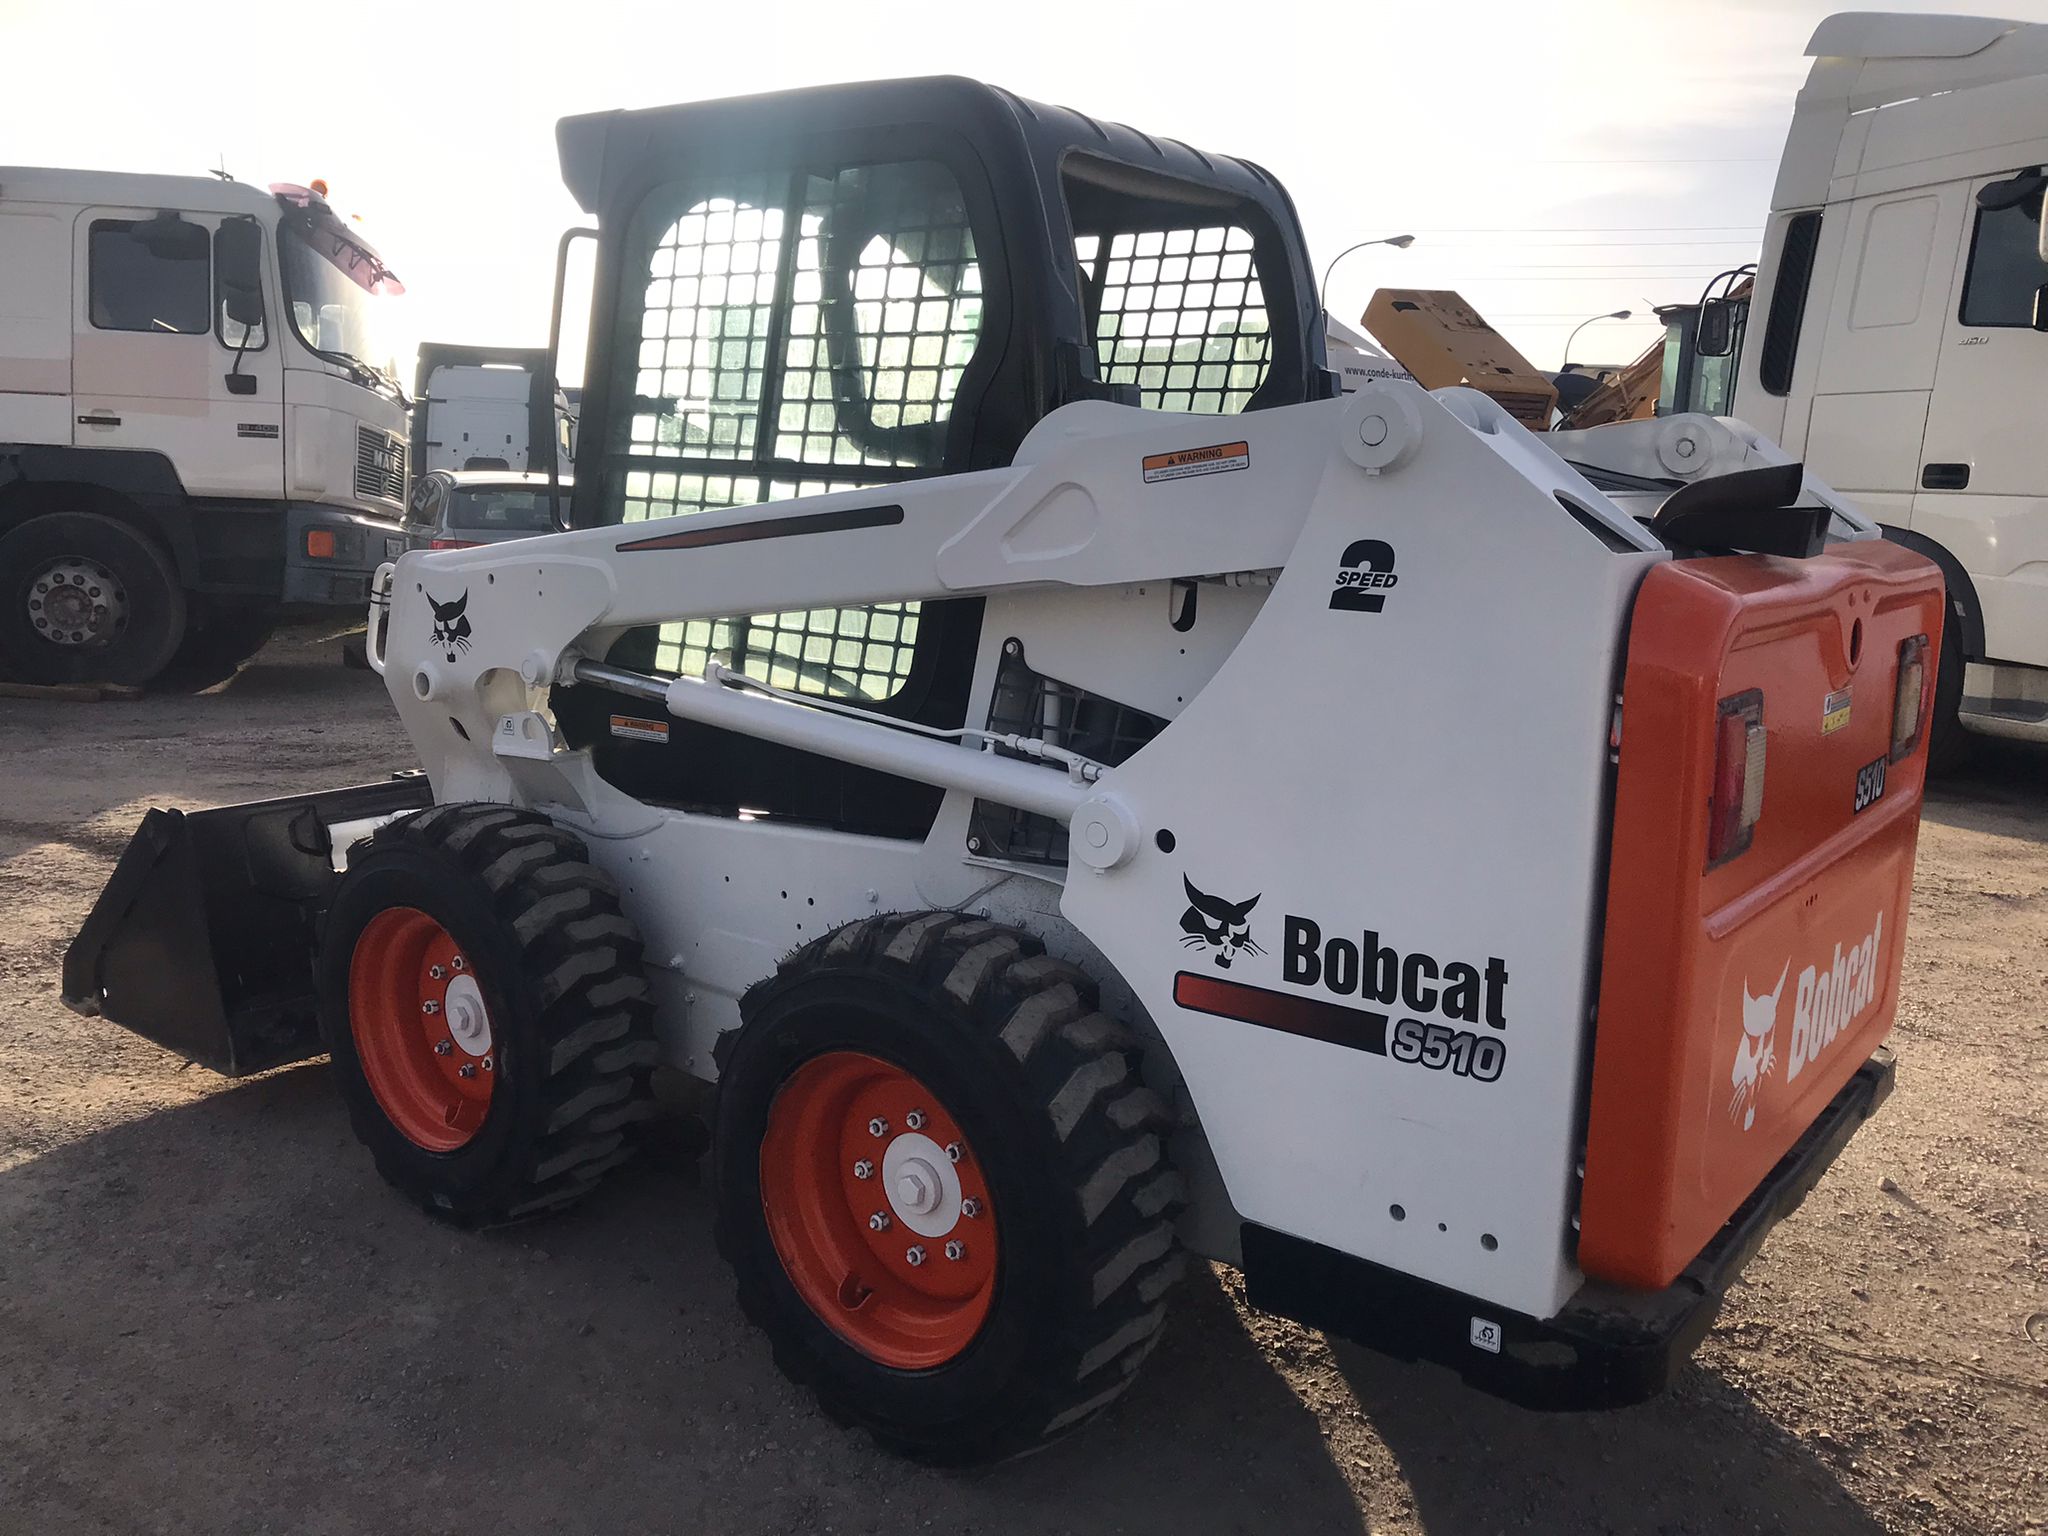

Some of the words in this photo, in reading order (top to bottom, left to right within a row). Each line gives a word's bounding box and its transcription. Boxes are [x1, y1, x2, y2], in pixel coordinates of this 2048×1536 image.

[1178, 448, 1223, 463] WARNING
[1328, 539, 1395, 614] 2
[1335, 571, 1399, 589] SPEED
[1855, 756, 1887, 812] S510
[1283, 914, 1509, 1031] Bobcat
[1787, 910, 1883, 1084] Bobcat
[1391, 1017, 1507, 1083] S510
